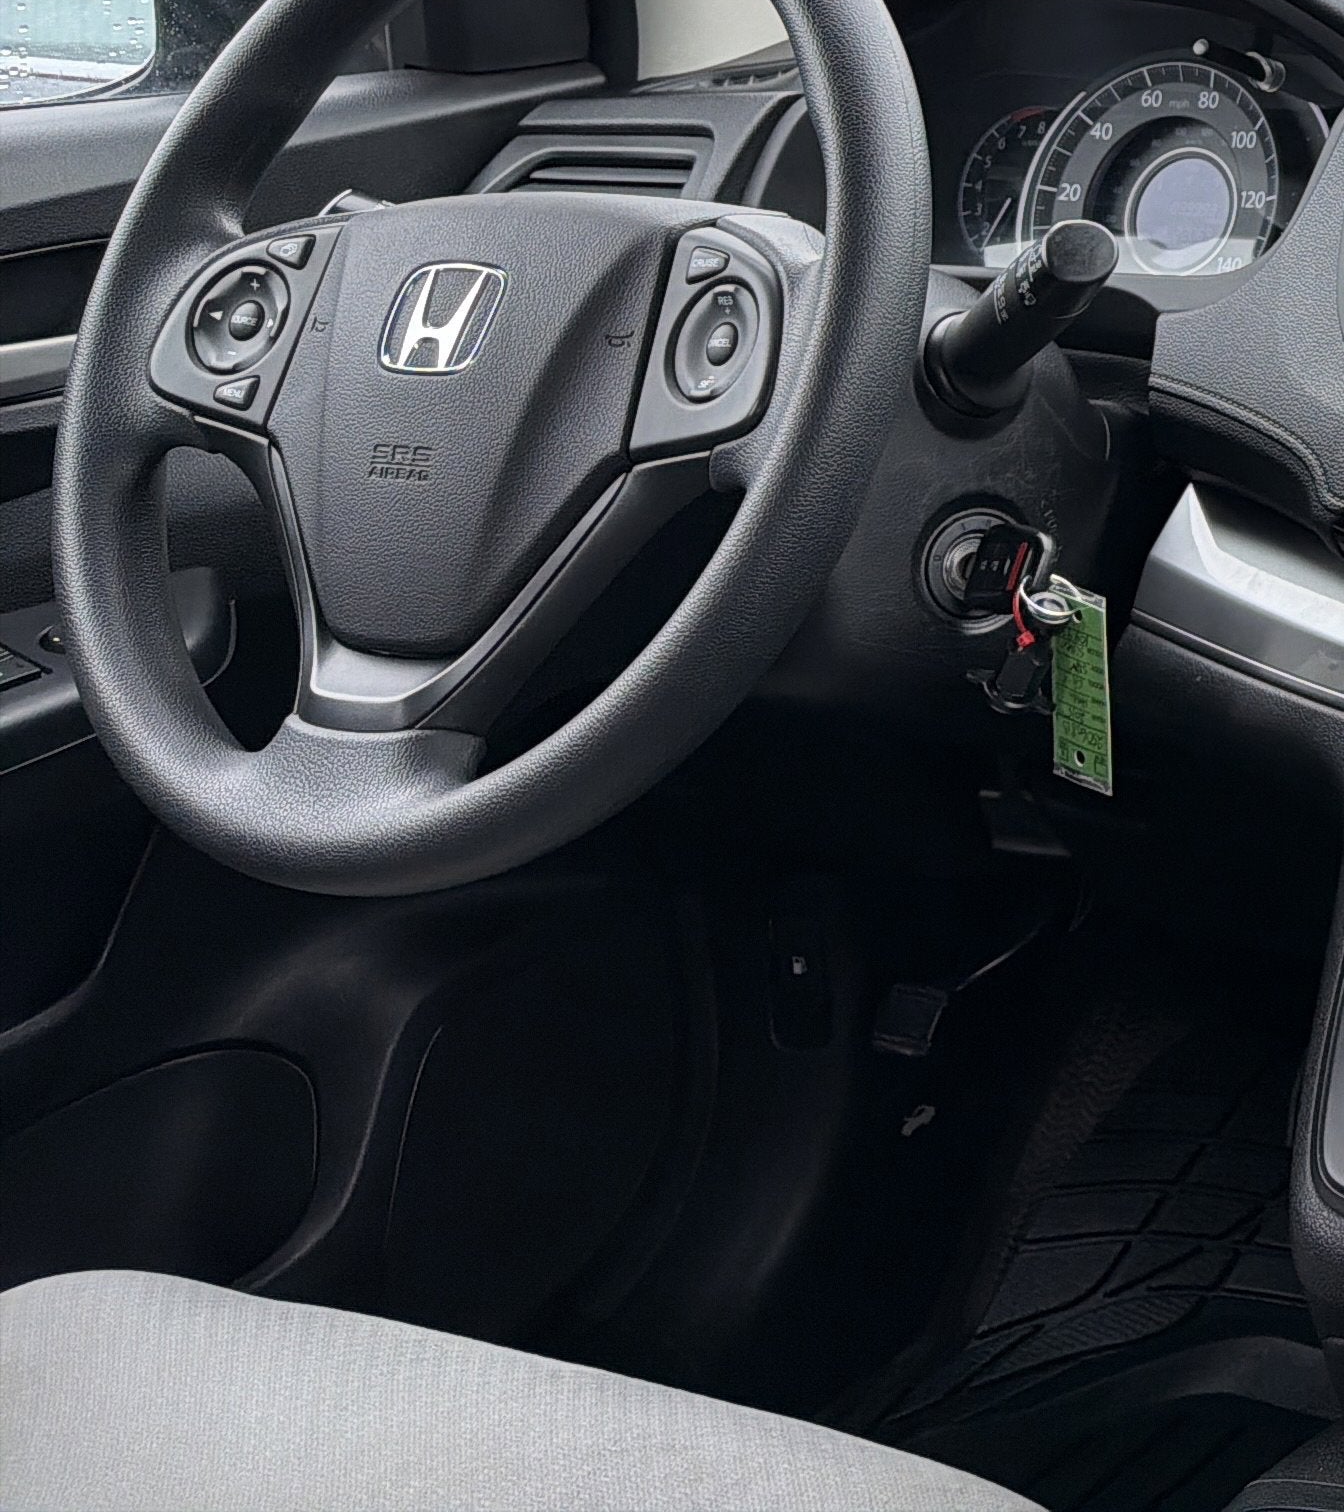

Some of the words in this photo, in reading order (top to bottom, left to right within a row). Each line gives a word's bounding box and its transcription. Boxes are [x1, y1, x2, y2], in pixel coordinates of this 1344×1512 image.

[1141, 90, 1162, 107] 60
[1198, 91, 1219, 109] 80
[1018, 125, 1026, 137] 7
[1037, 121, 1046, 134] 8
[1090, 123, 1113, 140] 40
[1231, 131, 1256, 149] 100
[984, 158, 991, 168] 5
[1058, 183, 1081, 201] 20
[1241, 191, 1265, 208] 120
[693, 257, 720, 268] CRUISE
[1217, 257, 1242, 272] 140
[718, 295, 734, 306] RES
[370, 444, 437, 463] SRS
